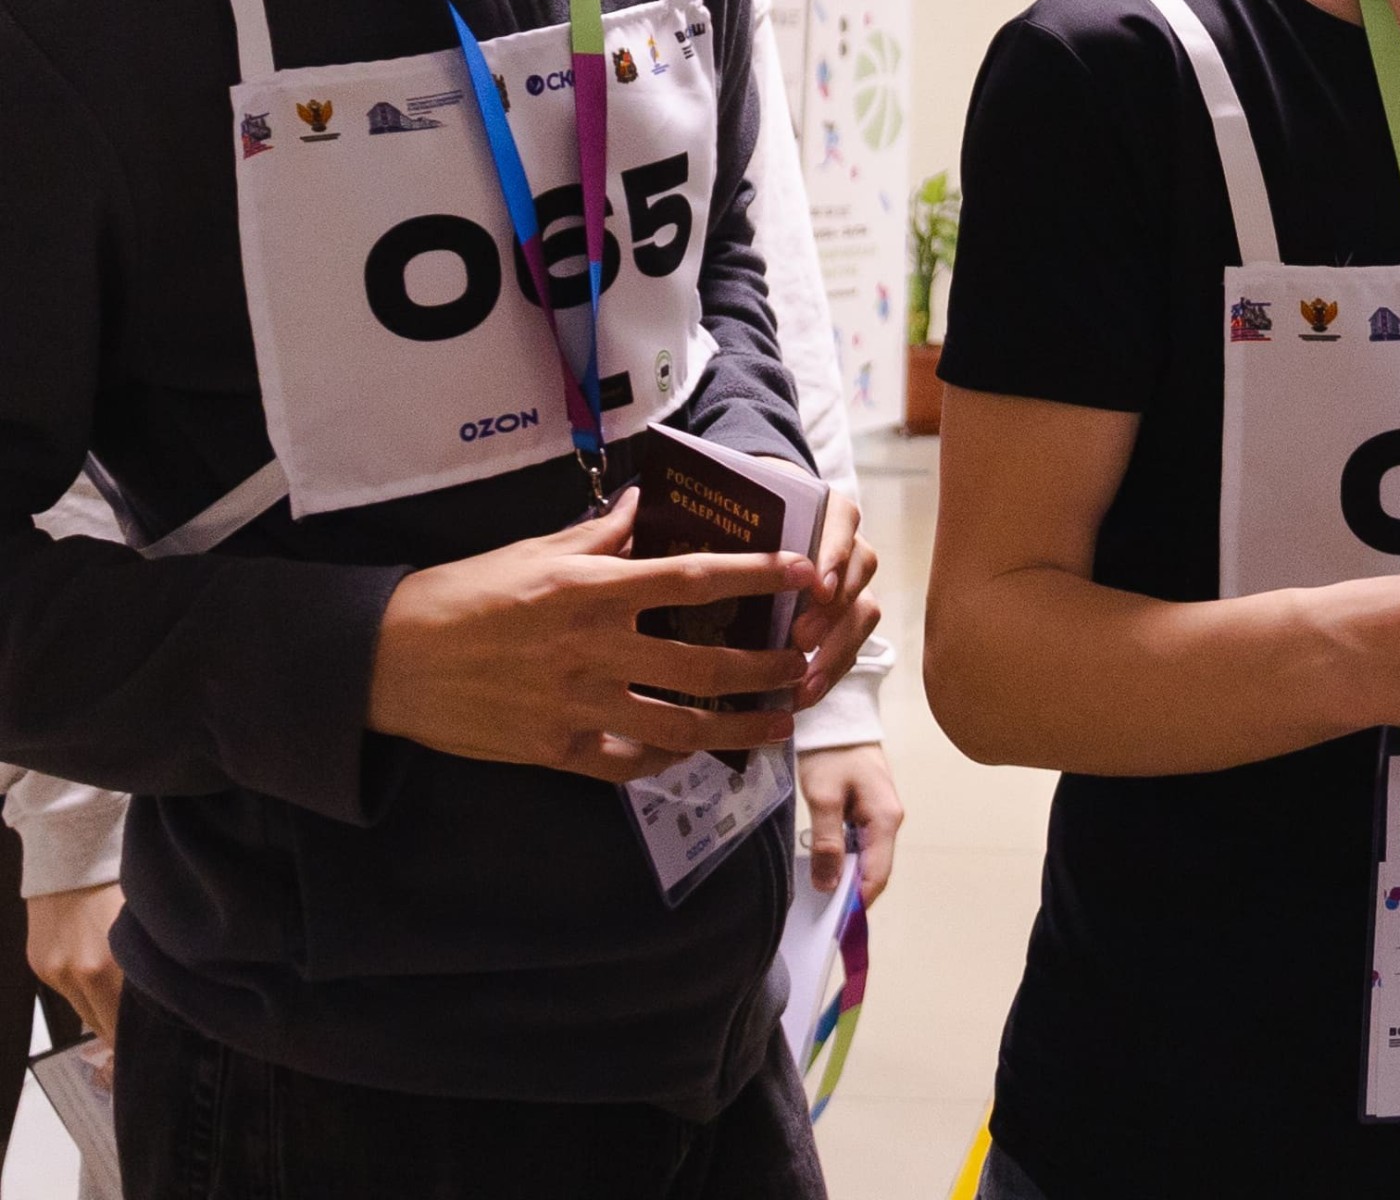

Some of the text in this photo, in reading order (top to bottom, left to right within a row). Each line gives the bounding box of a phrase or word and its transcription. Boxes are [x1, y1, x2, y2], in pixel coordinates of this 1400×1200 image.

[546, 69, 576, 91] СК
[364, 152, 694, 342] 065
[459, 408, 540, 442] OZON
[666, 467, 760, 527] РОССИЙСКАЯ
[670, 490, 752, 543] ФЕДЕРАЦИЯ
